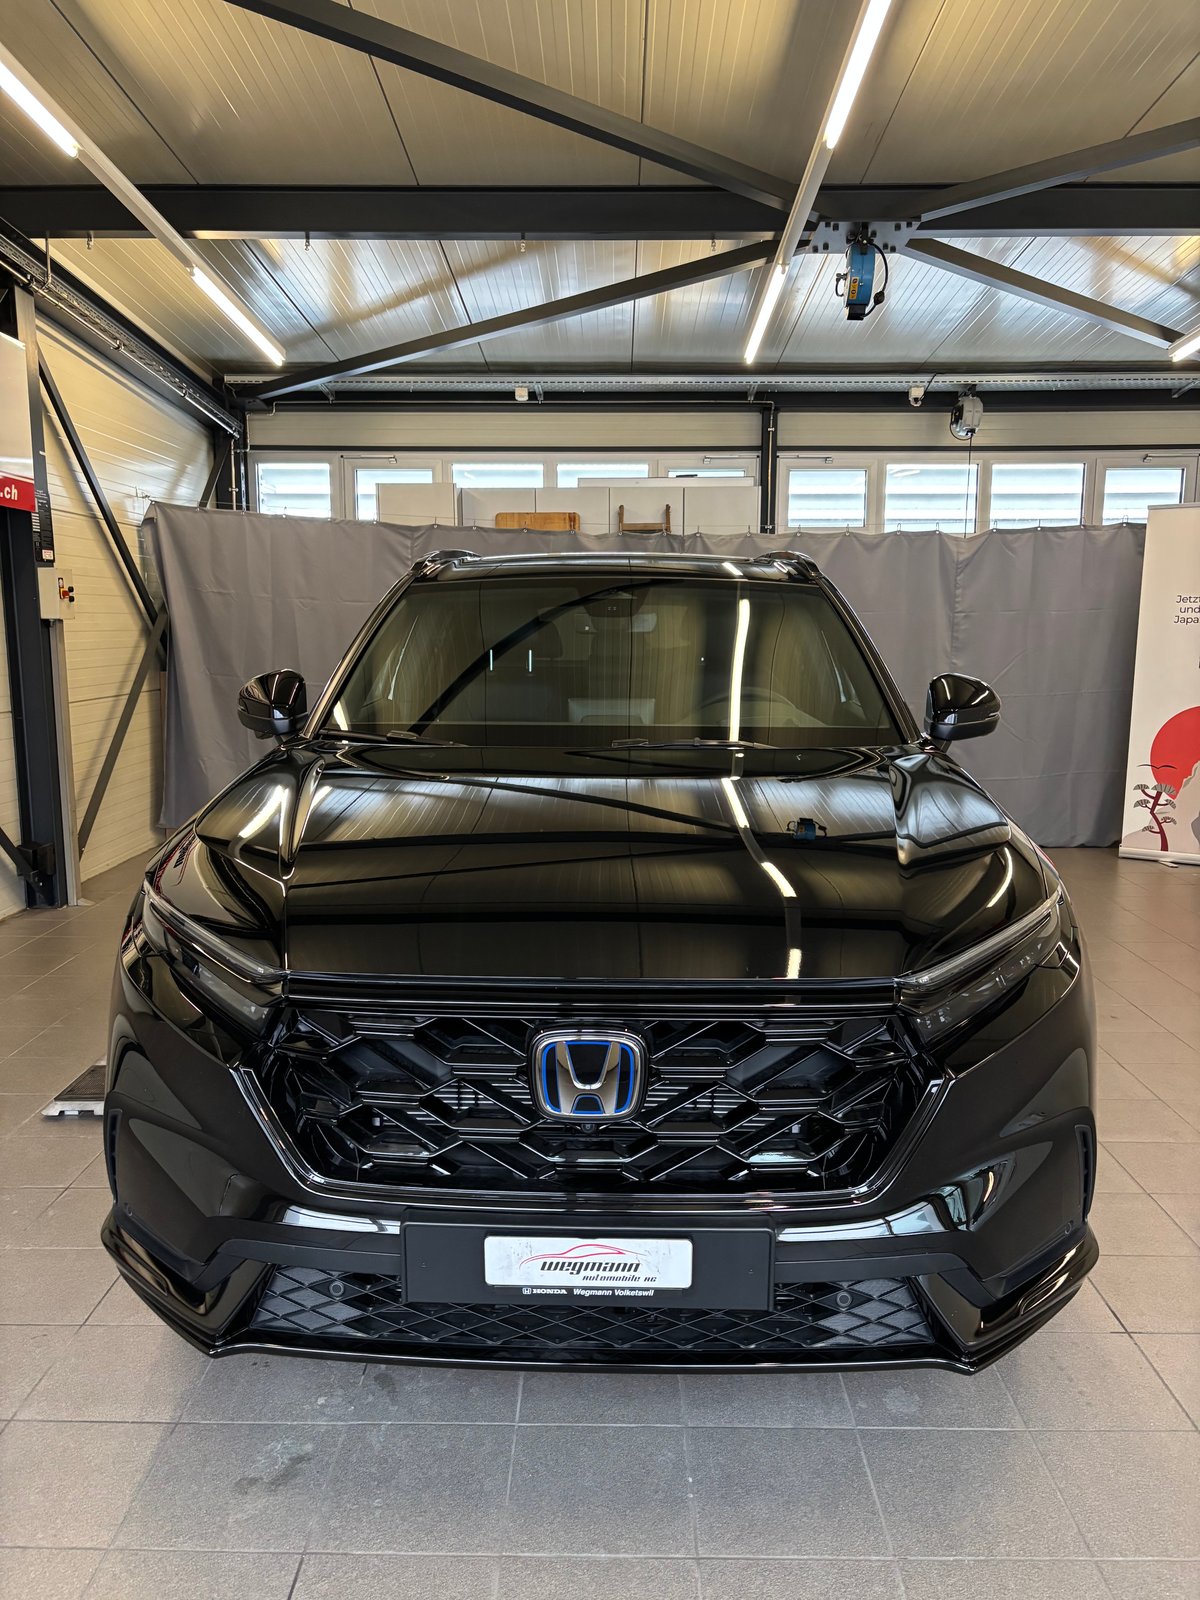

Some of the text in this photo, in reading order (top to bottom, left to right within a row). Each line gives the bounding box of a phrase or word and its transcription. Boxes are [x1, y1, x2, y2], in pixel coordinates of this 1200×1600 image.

[540, 1261, 641, 1275] wegmann
[582, 1274, 641, 1282] automobile
[573, 1288, 612, 1297] Wegmann
[614, 1289, 655, 1297] Volketswil
